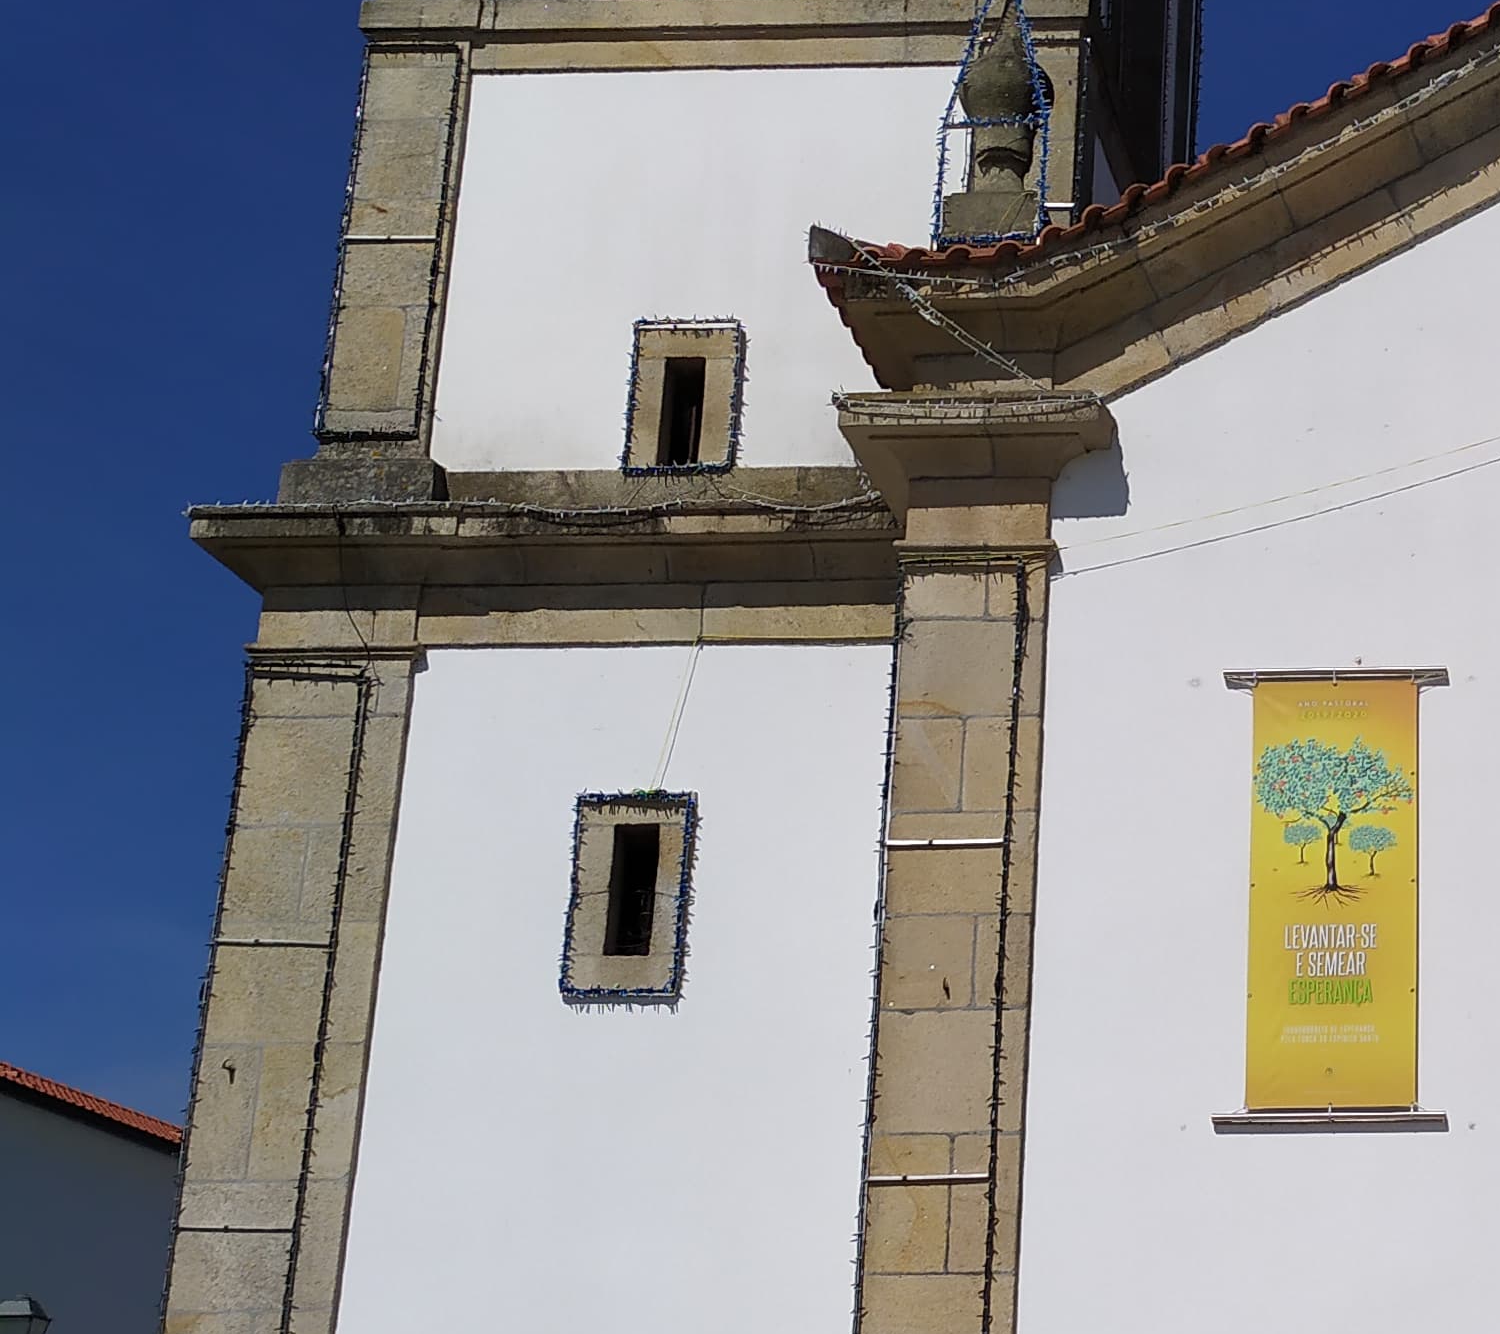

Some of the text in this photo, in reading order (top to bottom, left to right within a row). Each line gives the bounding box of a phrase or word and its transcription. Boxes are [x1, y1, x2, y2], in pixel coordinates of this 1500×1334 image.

[1285, 923, 1377, 949] LEVANTAR-SE
[1296, 951, 1366, 977] E SEMEAR
[1288, 979, 1373, 1007] ESPERANÇA
